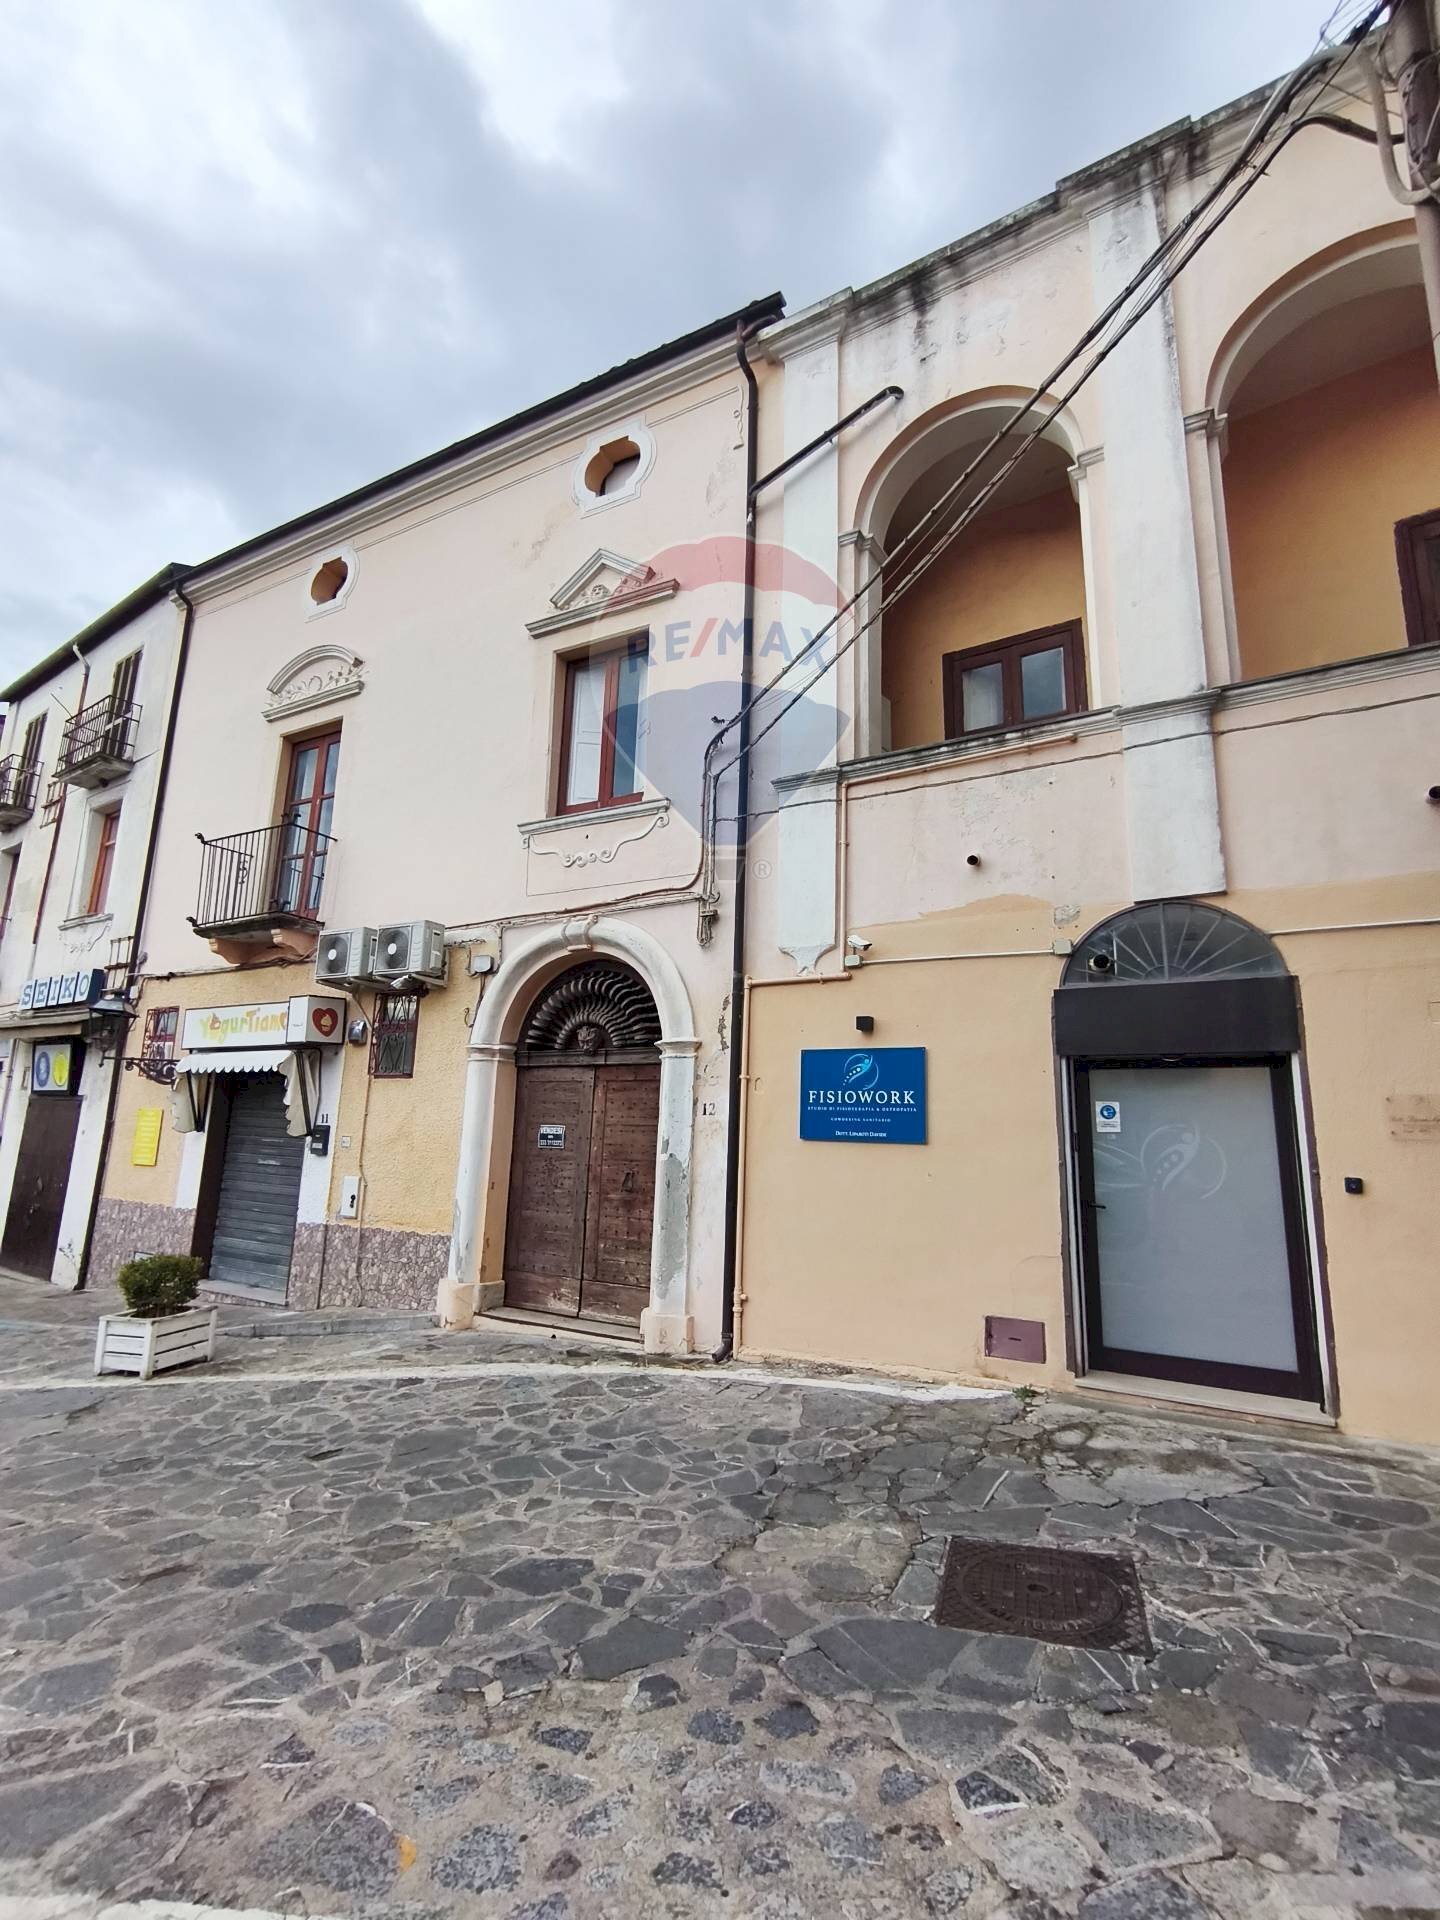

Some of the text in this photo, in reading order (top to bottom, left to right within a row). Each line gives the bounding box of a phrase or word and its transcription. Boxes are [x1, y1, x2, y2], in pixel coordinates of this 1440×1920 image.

[22, 973, 91, 1008] SEIKO
[808, 1090, 915, 1105] FISIOWORK
[701, 1102, 717, 1116] 12
[321, 1112, 329, 1124] 11
